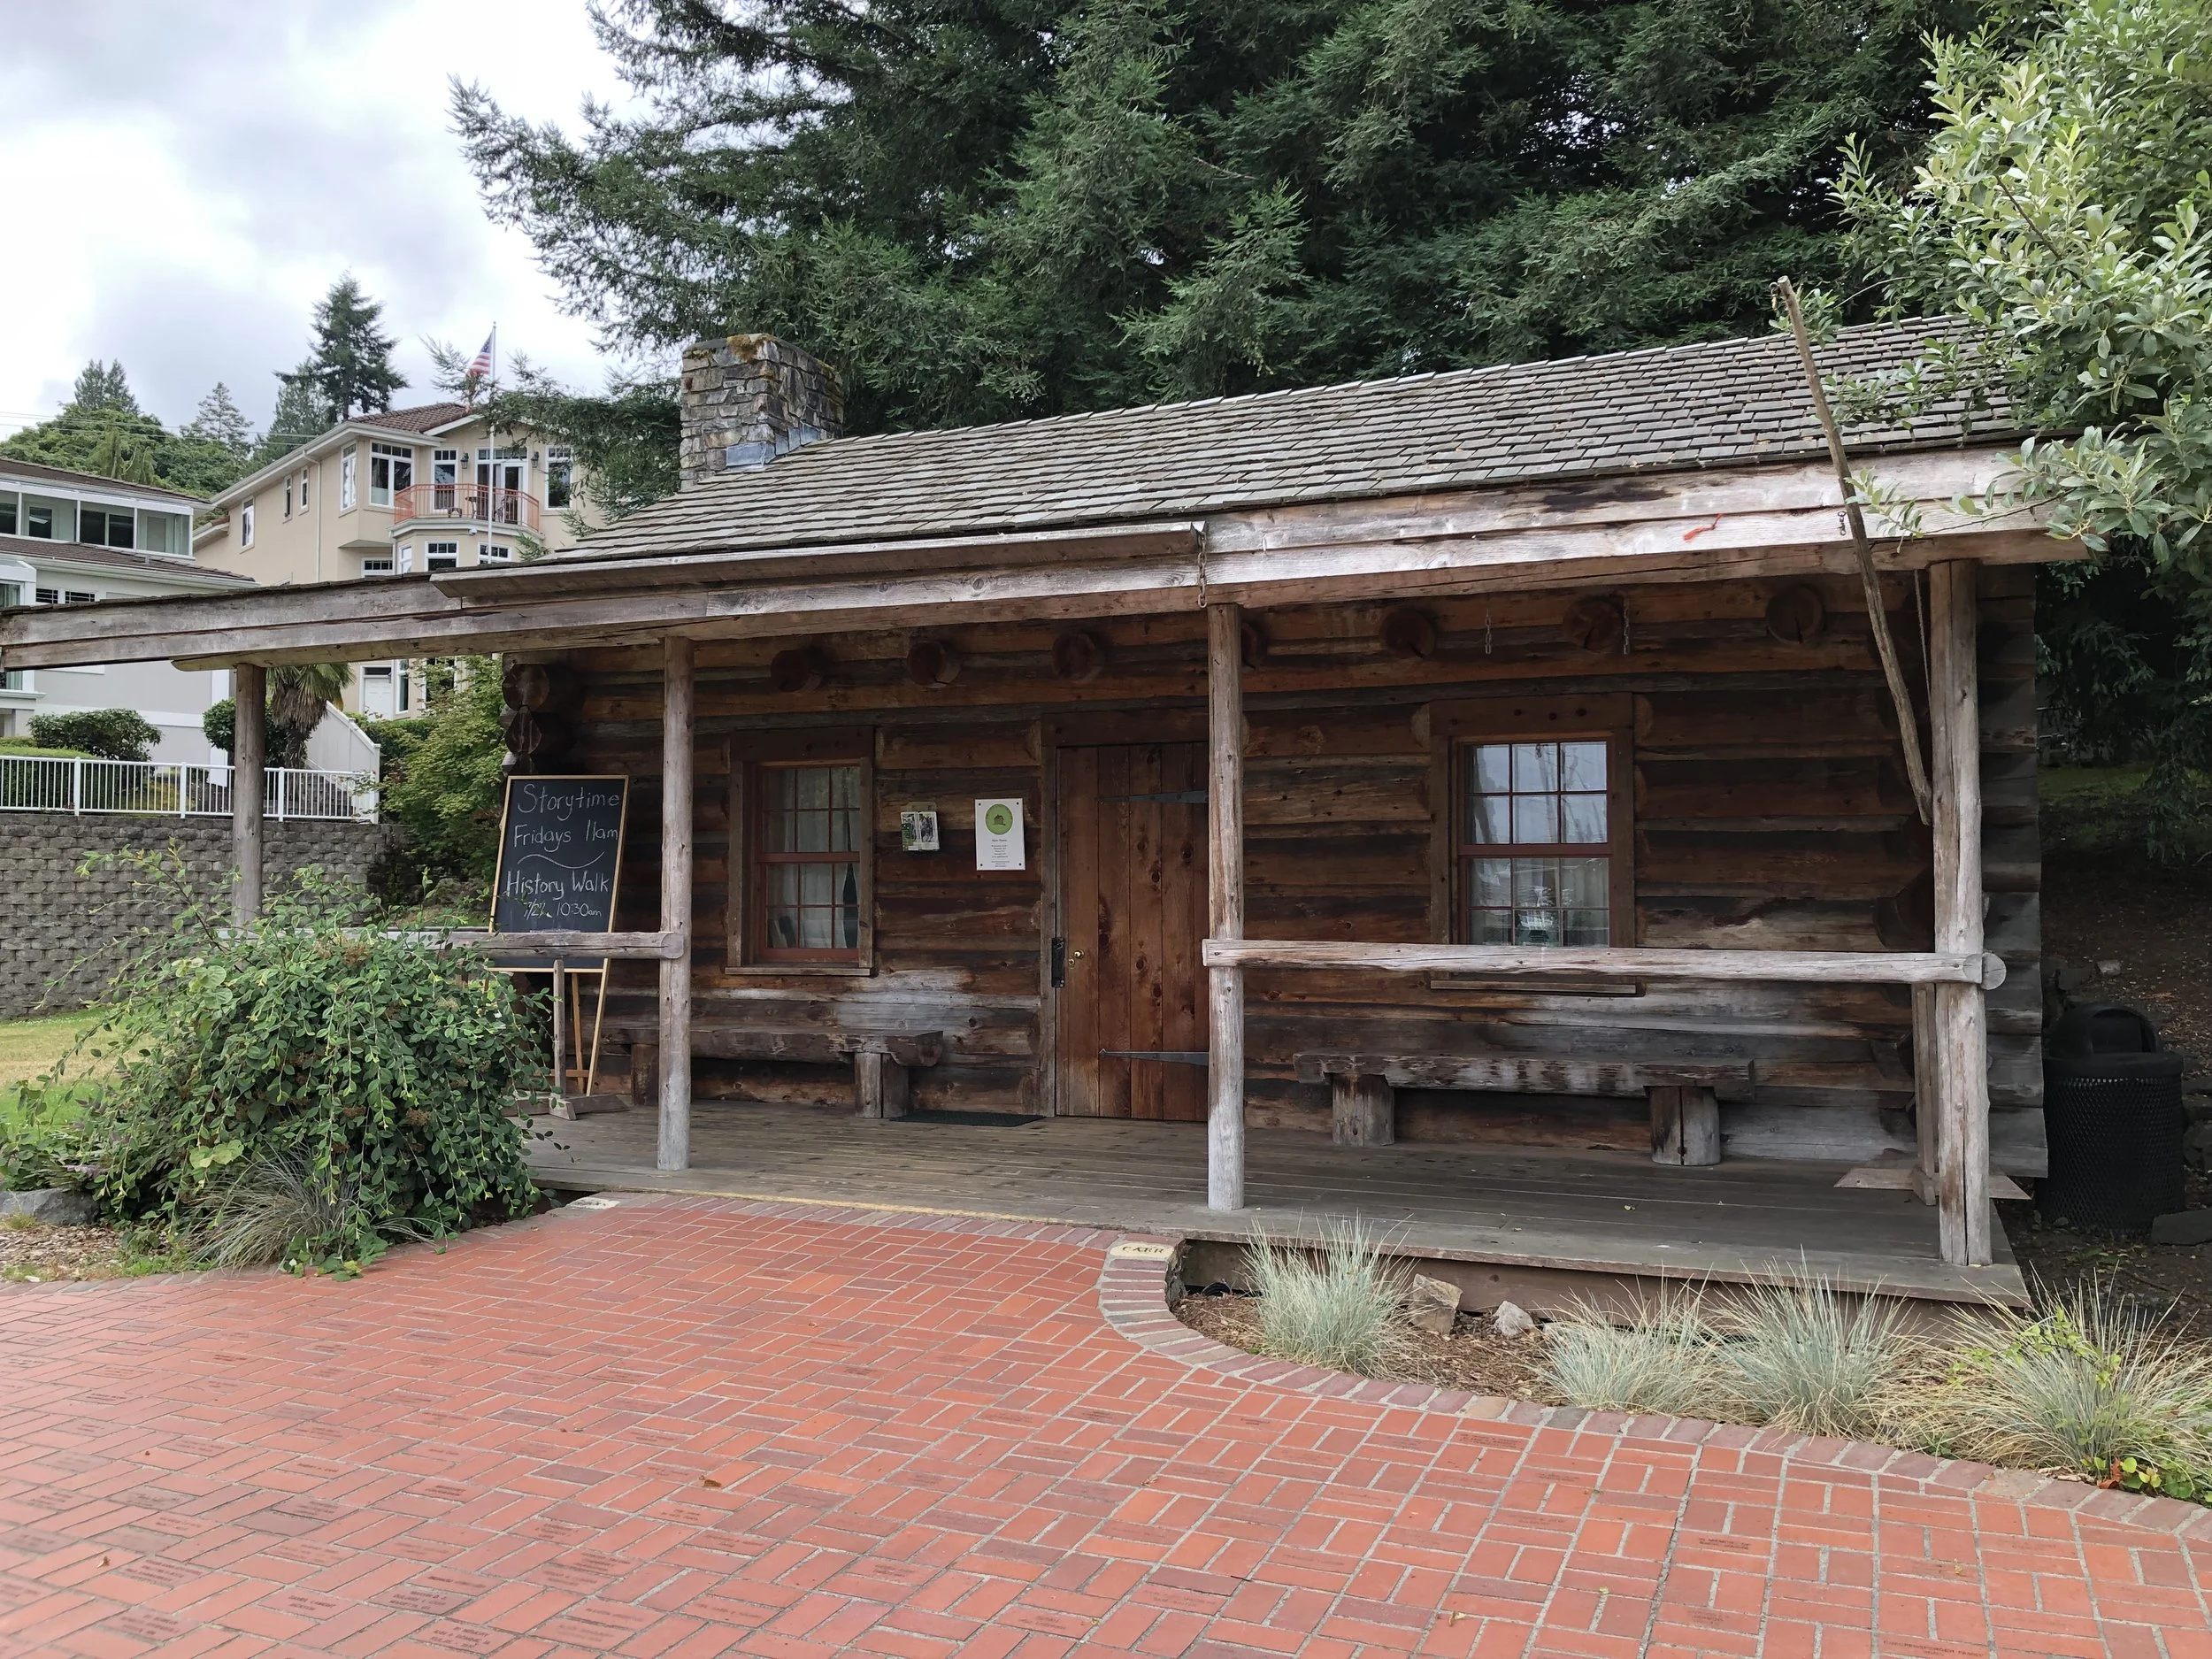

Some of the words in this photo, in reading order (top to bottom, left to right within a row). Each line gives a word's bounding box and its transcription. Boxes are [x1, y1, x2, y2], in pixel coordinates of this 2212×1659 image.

[518, 784, 618, 821] Storytime
[514, 824, 571, 852] Fridays
[586, 819, 618, 841] 11am
[505, 870, 565, 901] History
[572, 870, 609, 892] Walk
